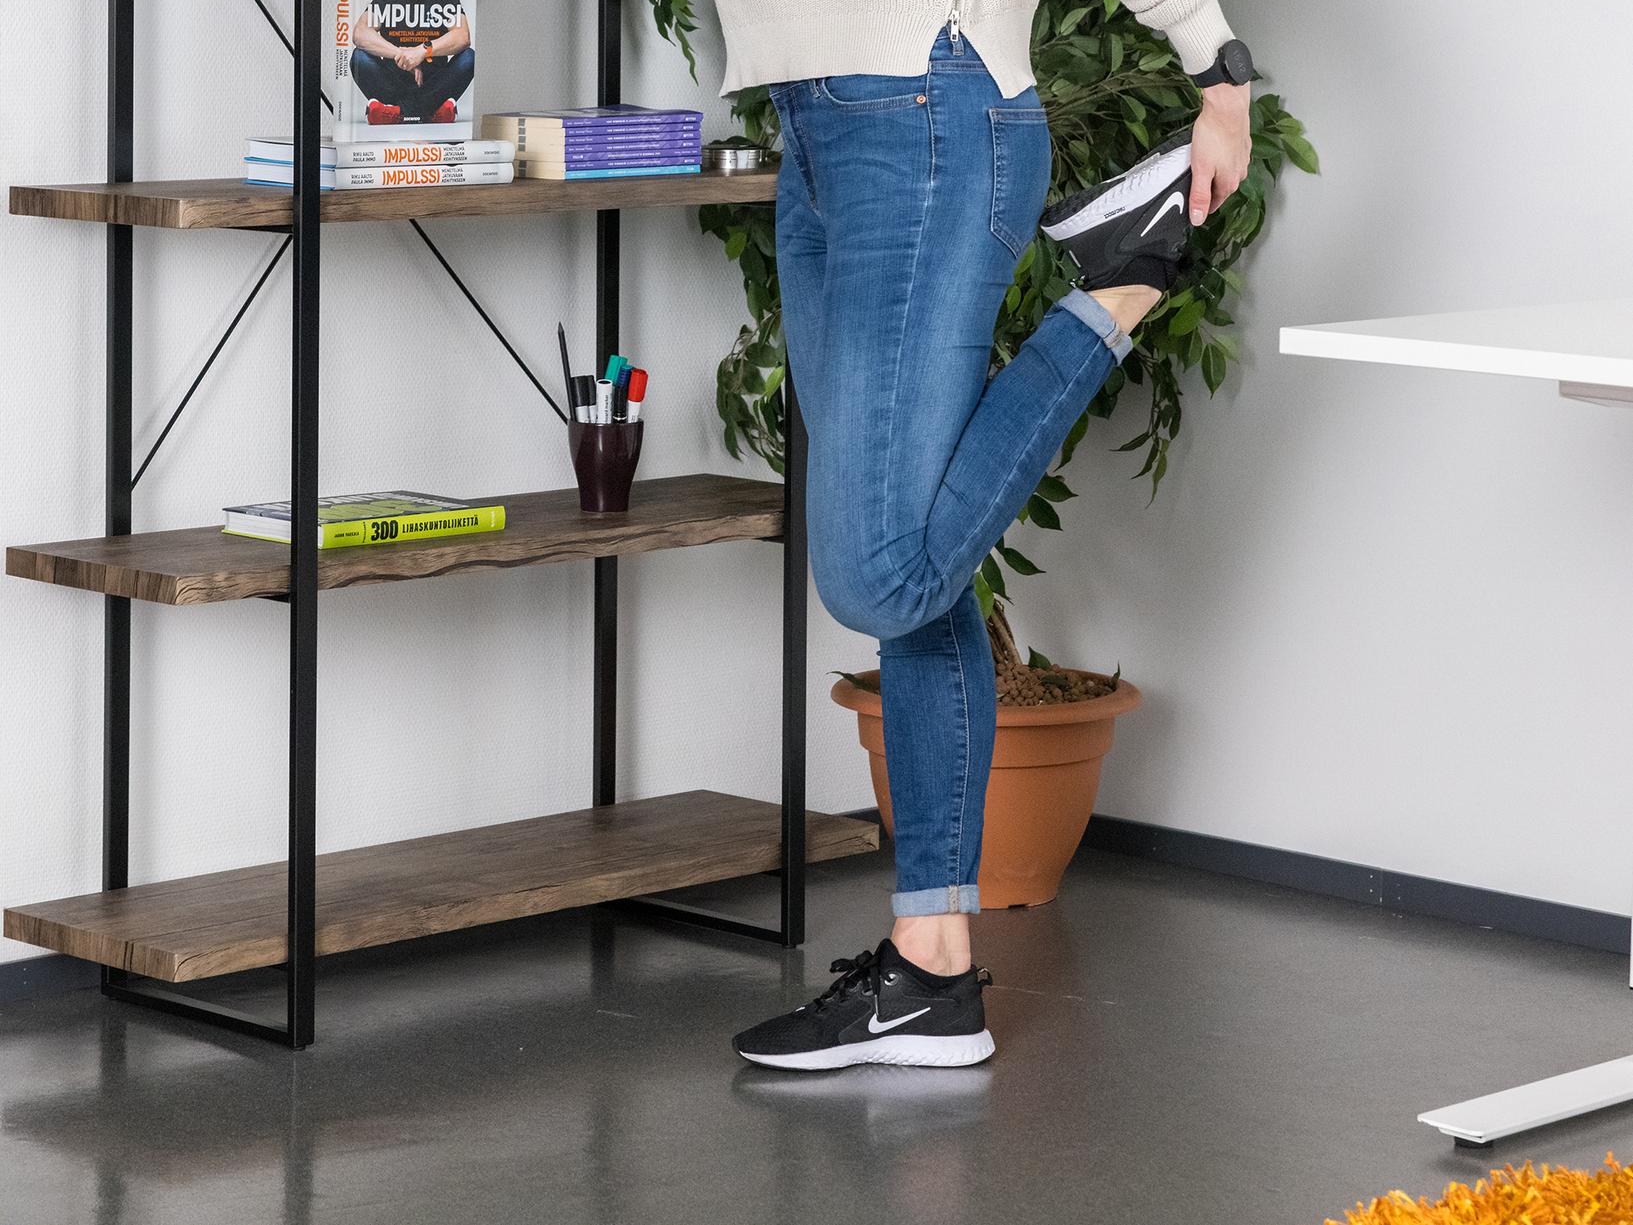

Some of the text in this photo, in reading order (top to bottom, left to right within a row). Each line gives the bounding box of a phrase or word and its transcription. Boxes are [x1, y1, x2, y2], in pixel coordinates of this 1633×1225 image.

[367, 3, 462, 28] IMPULSSI
[384, 146, 442, 163] IMPULSSI
[382, 168, 440, 185] IMPULSSI
[371, 520, 398, 541] 300
[402, 515, 479, 533] LIHASKUNTOLIIKETTÄ
